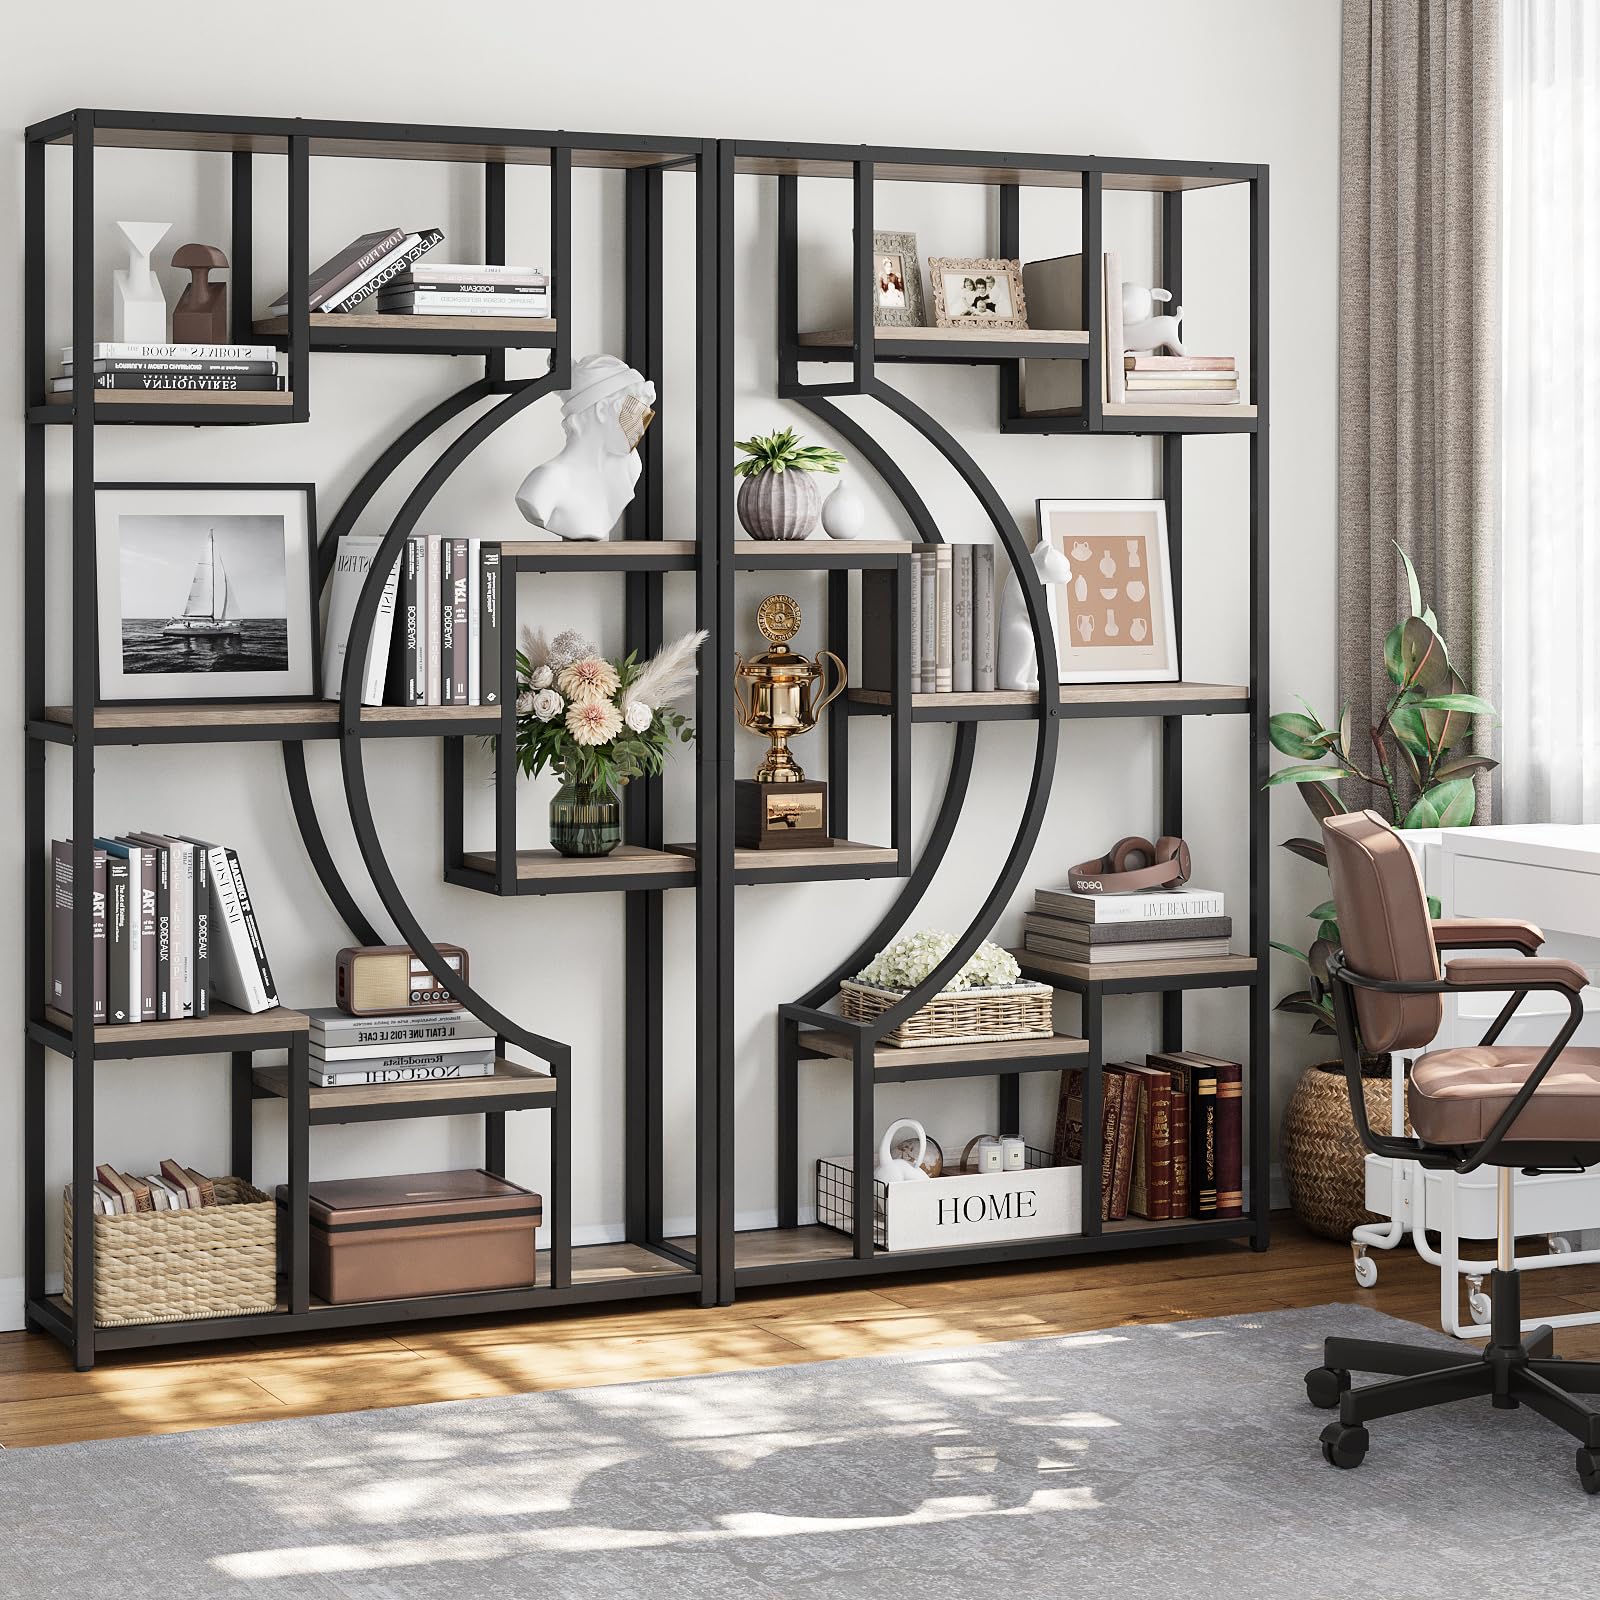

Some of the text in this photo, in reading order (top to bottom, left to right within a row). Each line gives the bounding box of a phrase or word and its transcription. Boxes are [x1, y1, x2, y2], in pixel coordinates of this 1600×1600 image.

[142, 889, 155, 916] ART
[212, 853, 240, 923] LOST FISH
[229, 858, 250, 912] MAKING IT
[1076, 881, 1103, 891] beats
[93, 891, 104, 918] ART
[1143, 903, 1164, 917] LIVE
[1168, 900, 1220, 916] BEAUTIFUL
[160, 916, 169, 961] BORDEAUX
[199, 914, 207, 959] BORDEAUX
[936, 1190, 1037, 1226] HOME
